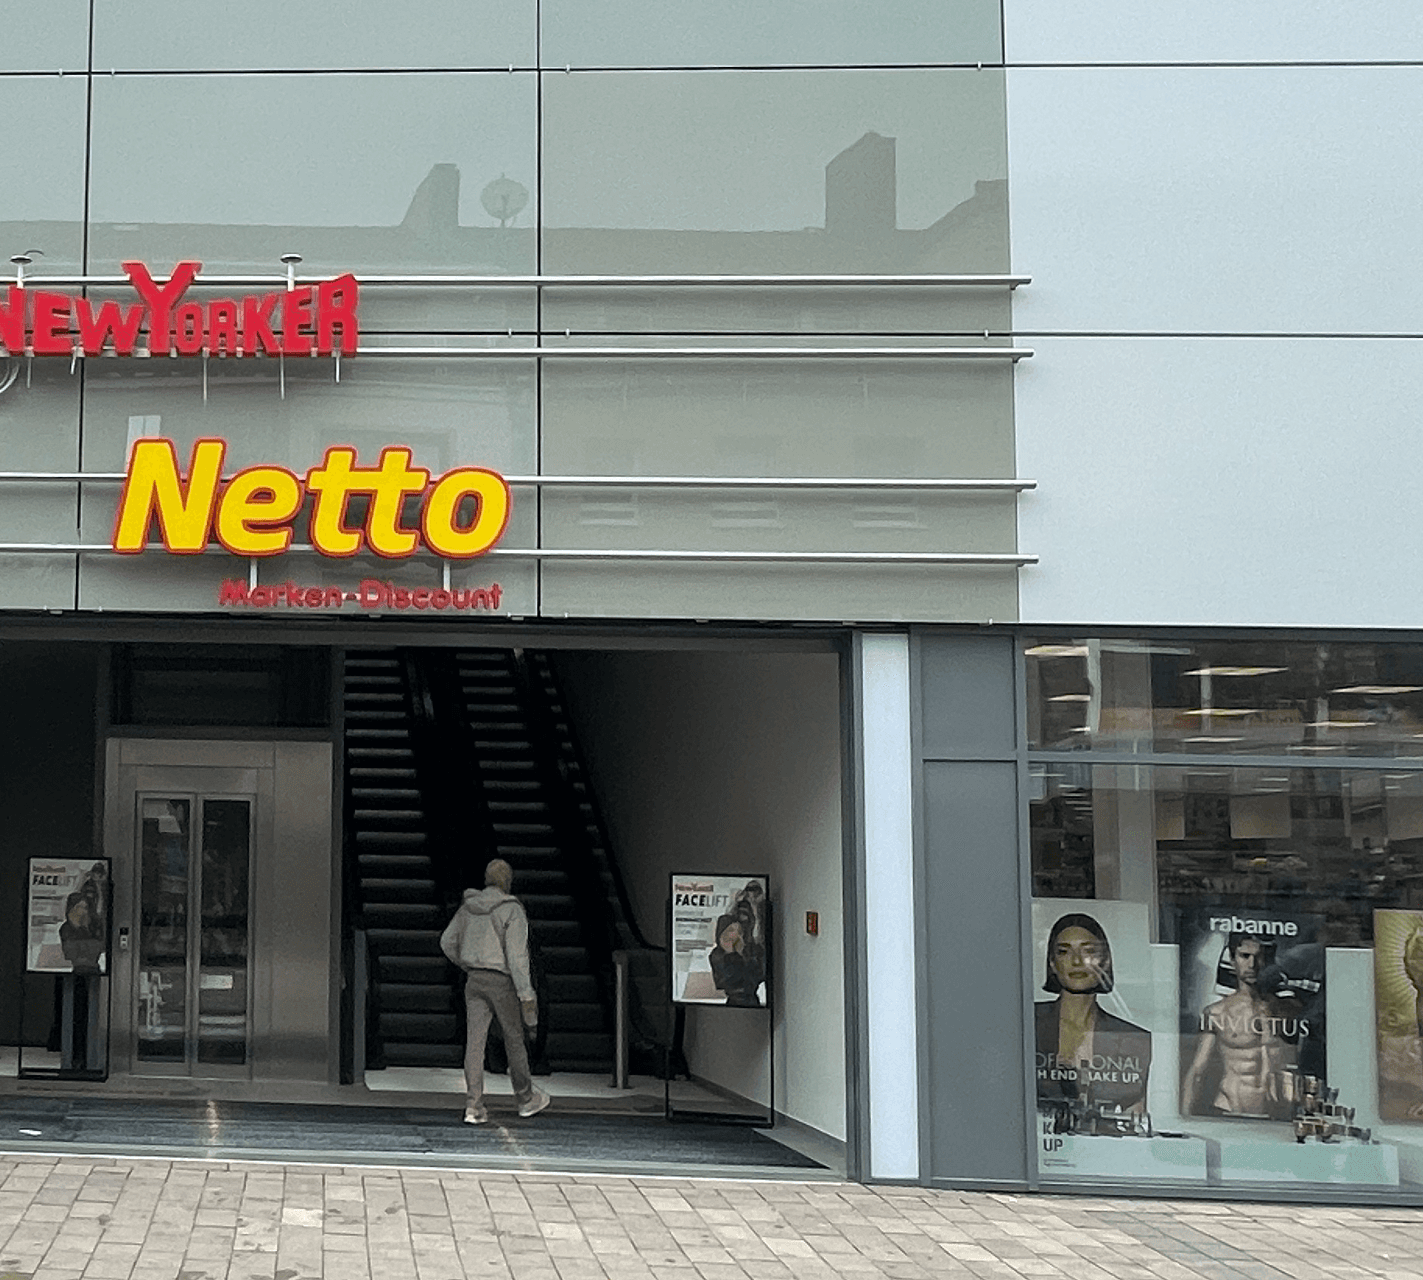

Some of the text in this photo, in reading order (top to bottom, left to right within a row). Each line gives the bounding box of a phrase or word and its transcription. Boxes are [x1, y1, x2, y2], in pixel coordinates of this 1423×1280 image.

[112, 438, 511, 558] Netto
[218, 578, 502, 610] Marken-Discount
[675, 894, 729, 907] FACELIFT
[1209, 916, 1298, 936] rabanne
[1200, 1013, 1310, 1037] INVICTUS
[1050, 1070, 1077, 1080] END
[1043, 1138, 1063, 1152] UP
